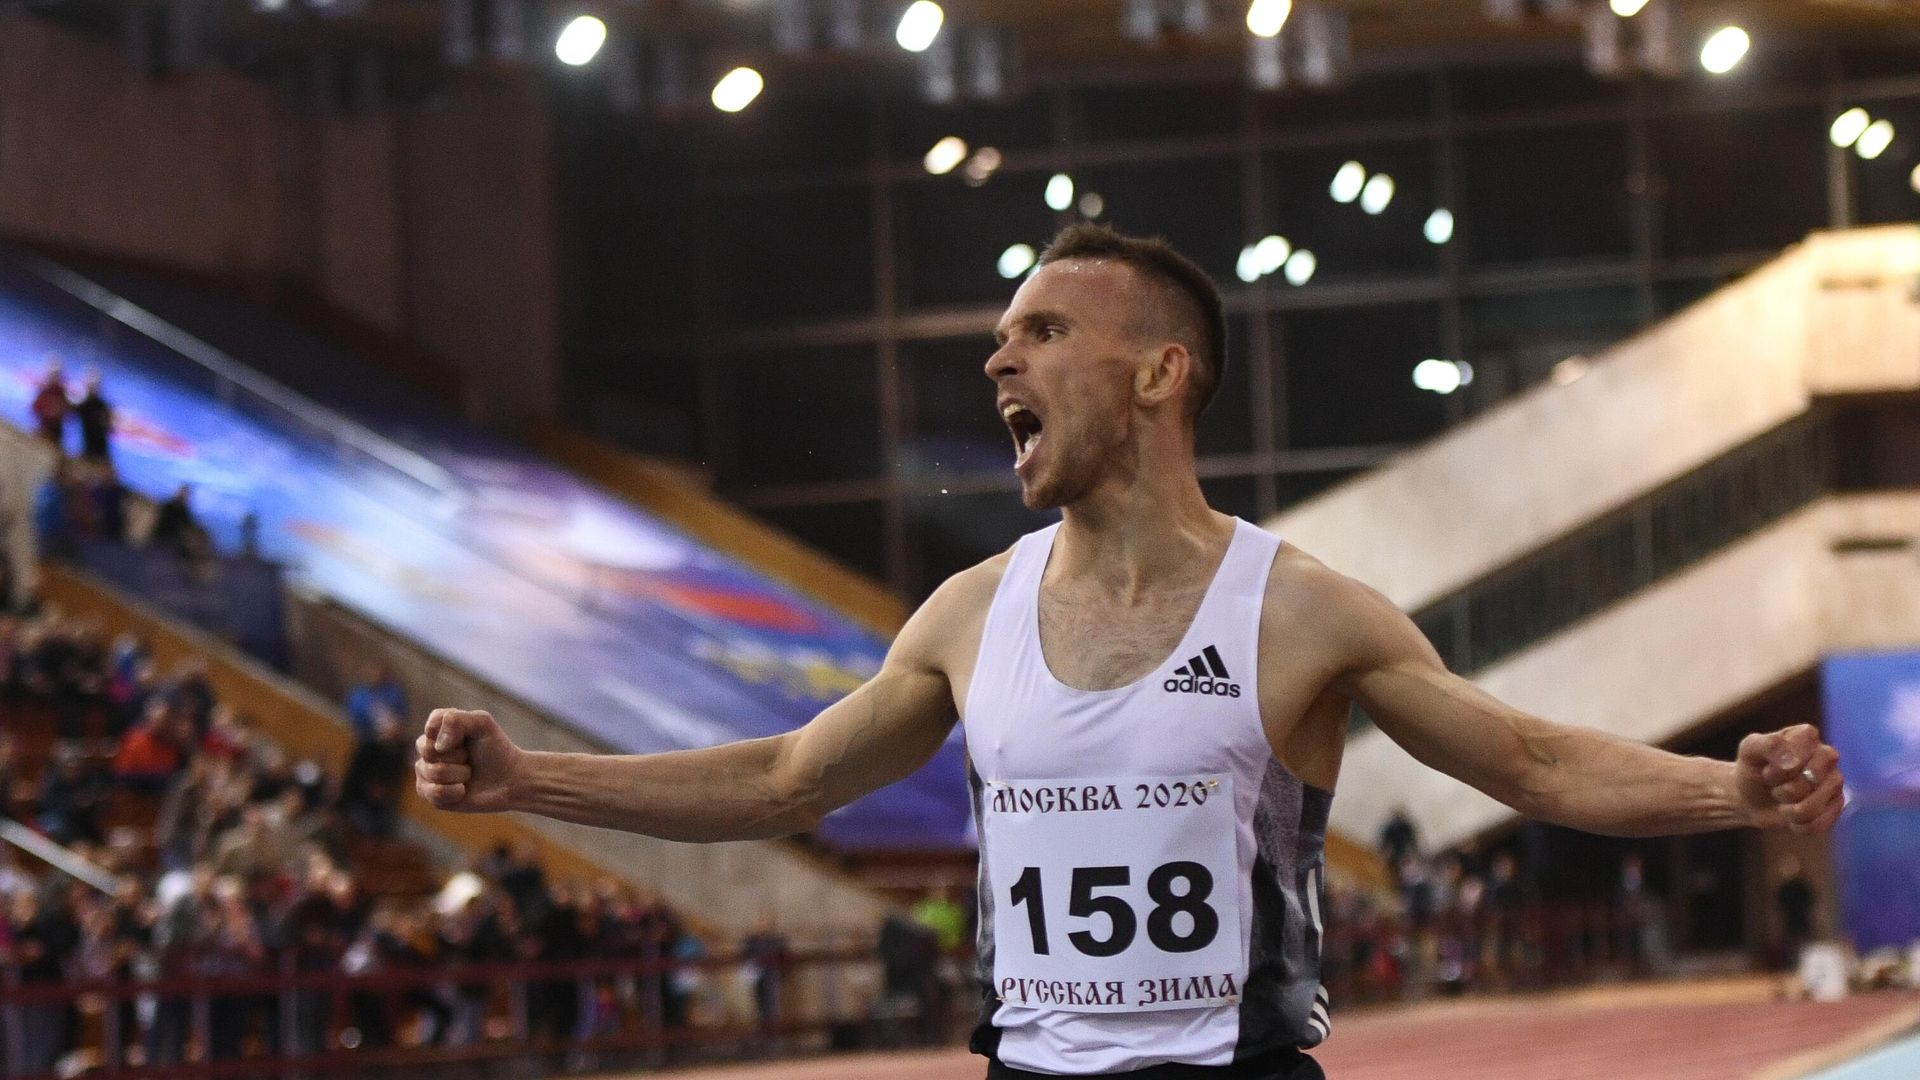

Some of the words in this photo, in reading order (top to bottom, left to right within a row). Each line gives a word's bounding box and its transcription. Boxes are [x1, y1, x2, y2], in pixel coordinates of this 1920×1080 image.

[1164, 675, 1241, 698] adidas
[993, 784, 1123, 813] МОСКВА
[1136, 781, 1209, 809] 2020
[1010, 861, 1219, 958] 158
[1001, 977, 1126, 1005] РУССКАЯ
[1138, 973, 1239, 1007] ЗИМА
